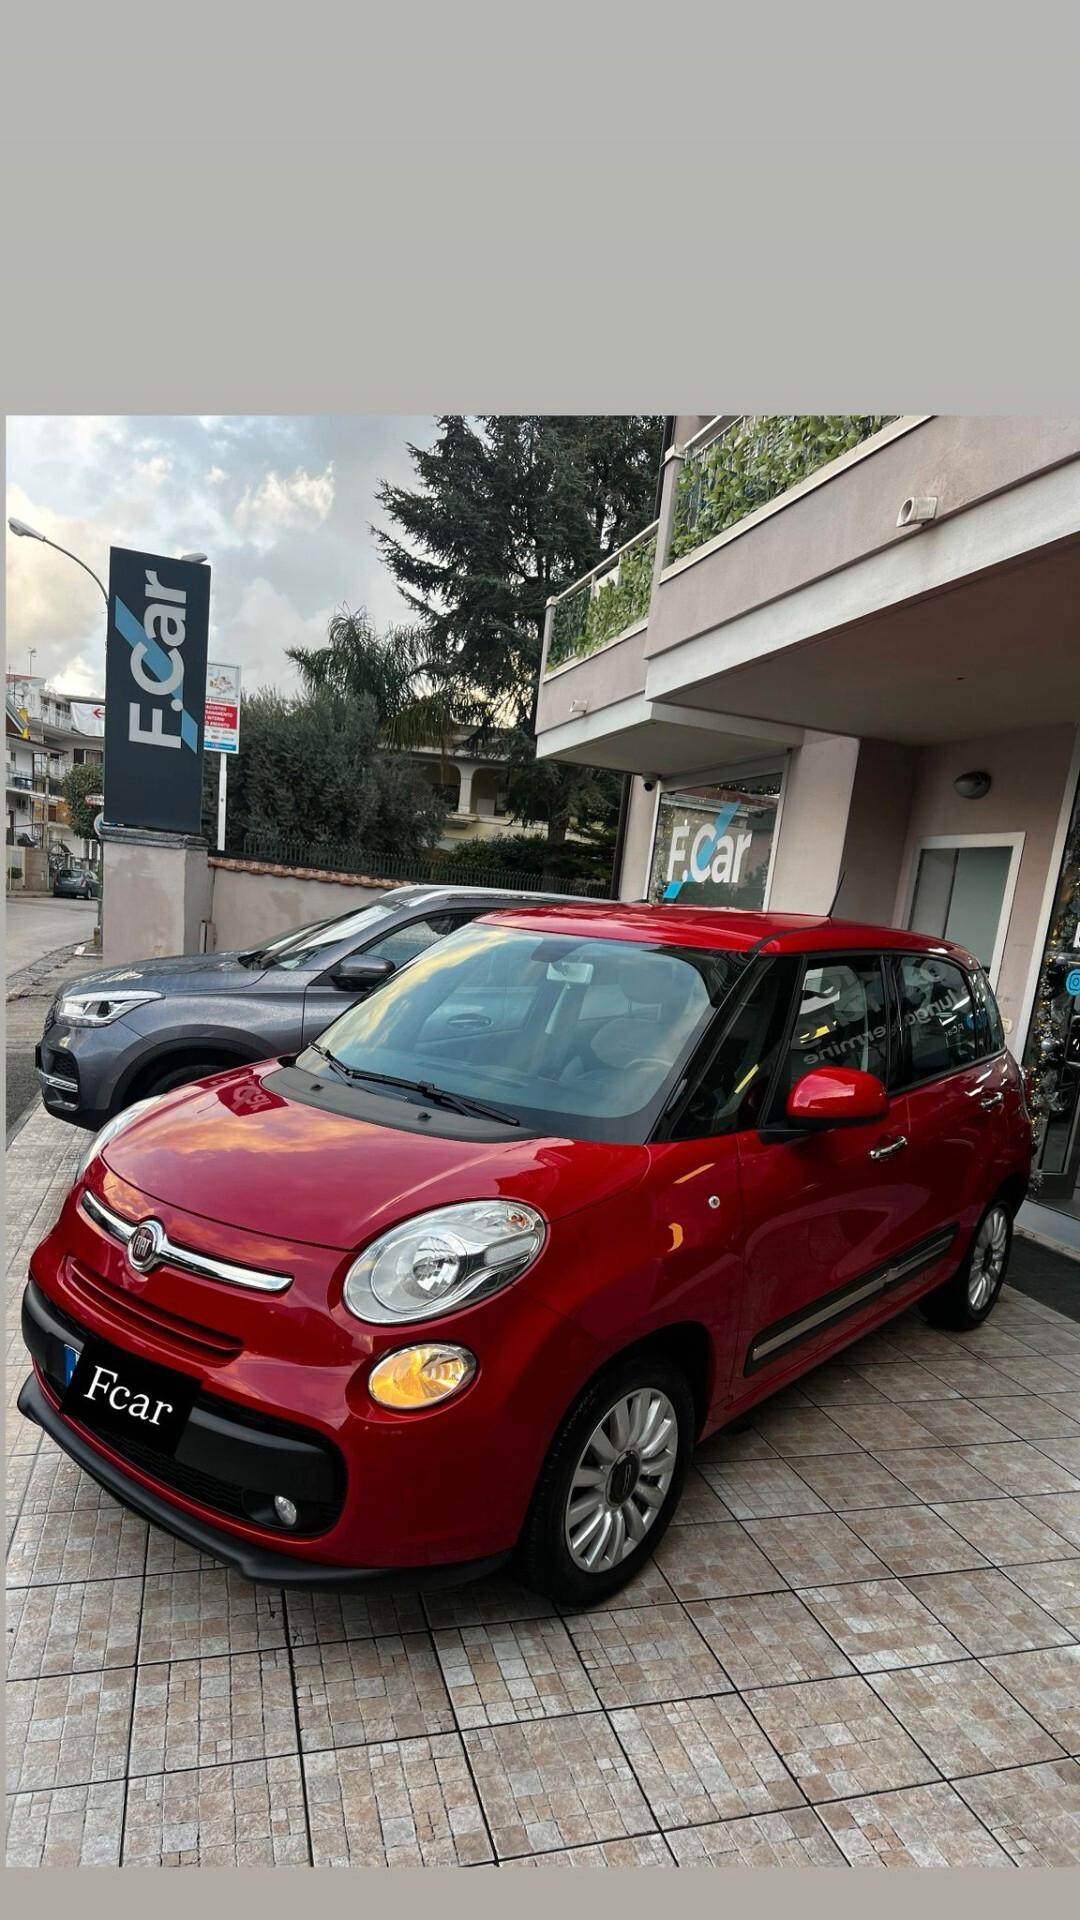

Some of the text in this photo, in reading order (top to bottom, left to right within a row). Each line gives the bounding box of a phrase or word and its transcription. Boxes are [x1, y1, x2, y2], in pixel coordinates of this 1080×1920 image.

[128, 569, 187, 750] F.Car
[666, 823, 753, 883] F.Car
[133, 1235, 152, 1257] FIAT
